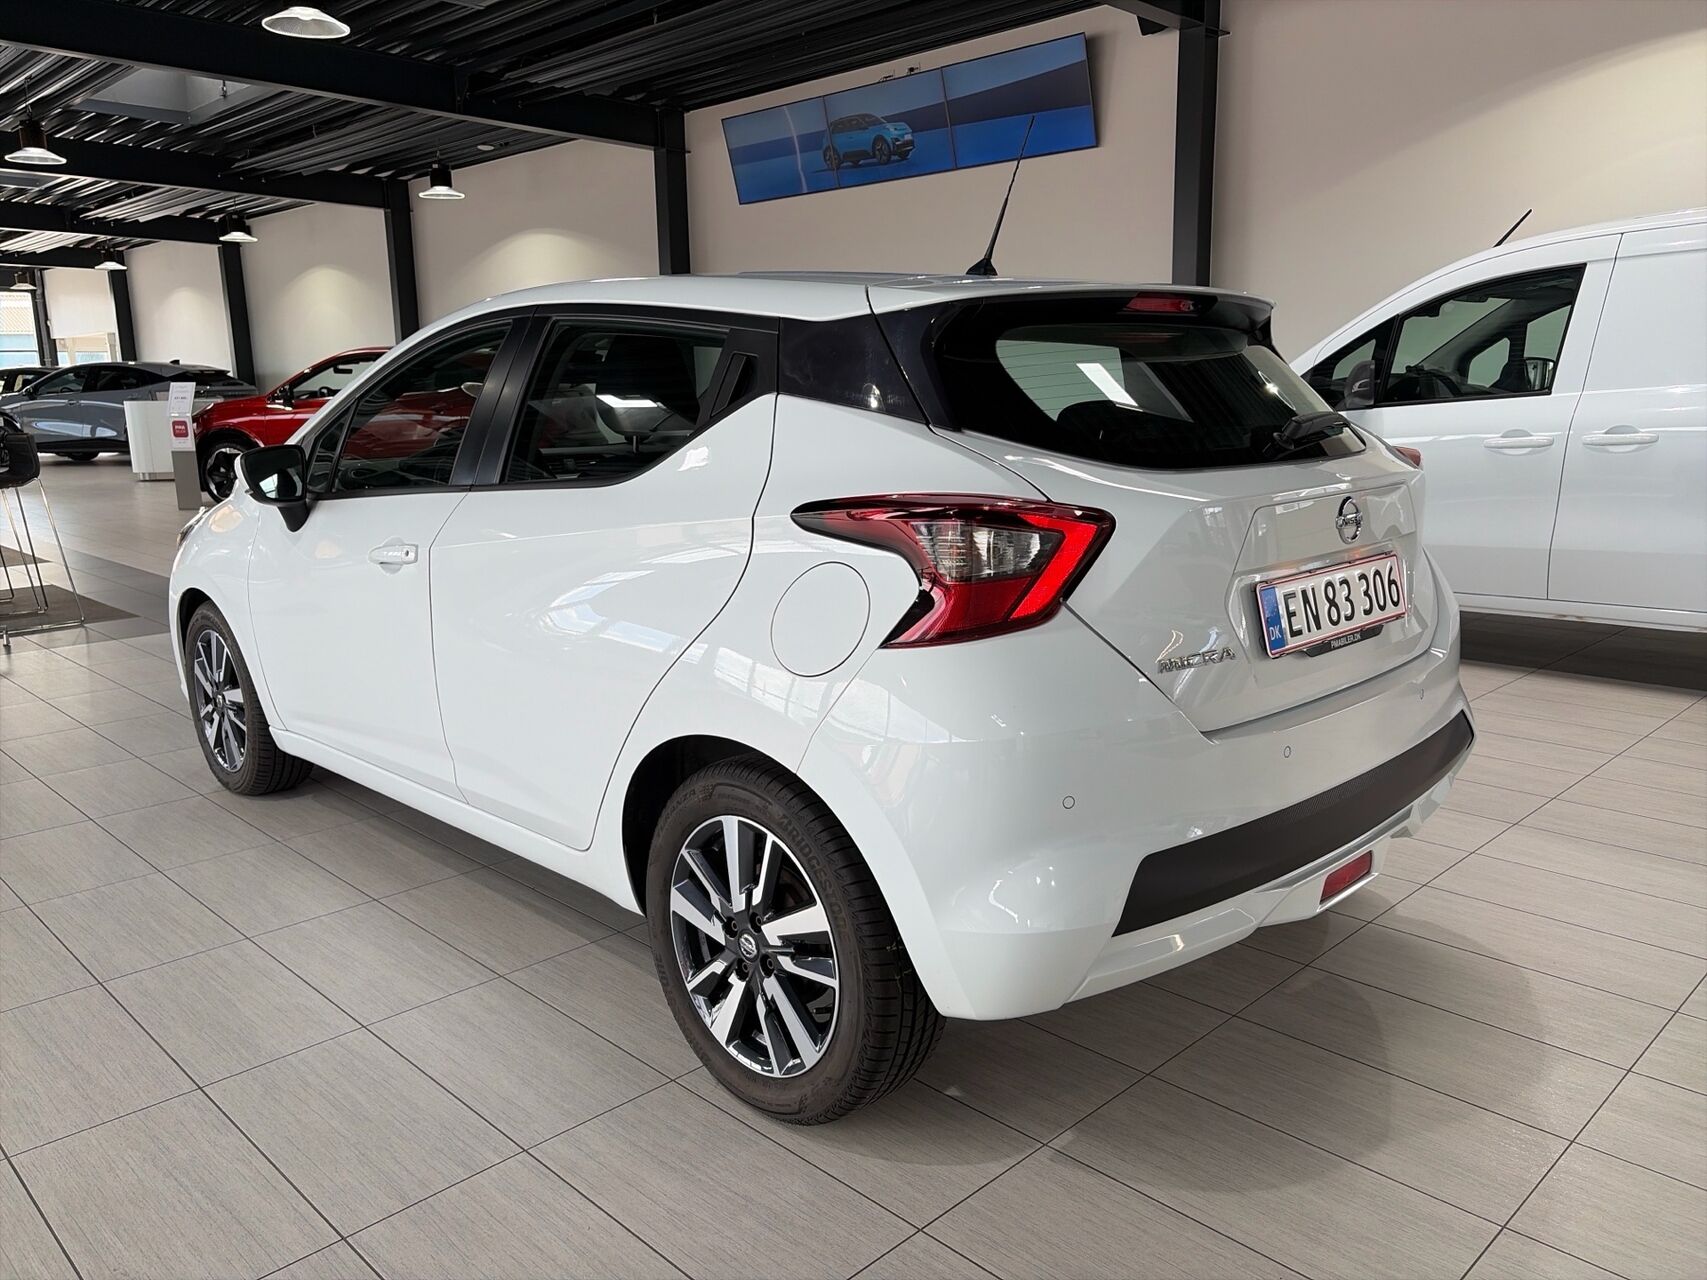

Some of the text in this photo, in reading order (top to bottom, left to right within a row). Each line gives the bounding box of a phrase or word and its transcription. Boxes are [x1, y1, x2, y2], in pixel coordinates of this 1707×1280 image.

[1282, 564, 1400, 638] EN 83 306
[1269, 626, 1282, 641] DK
